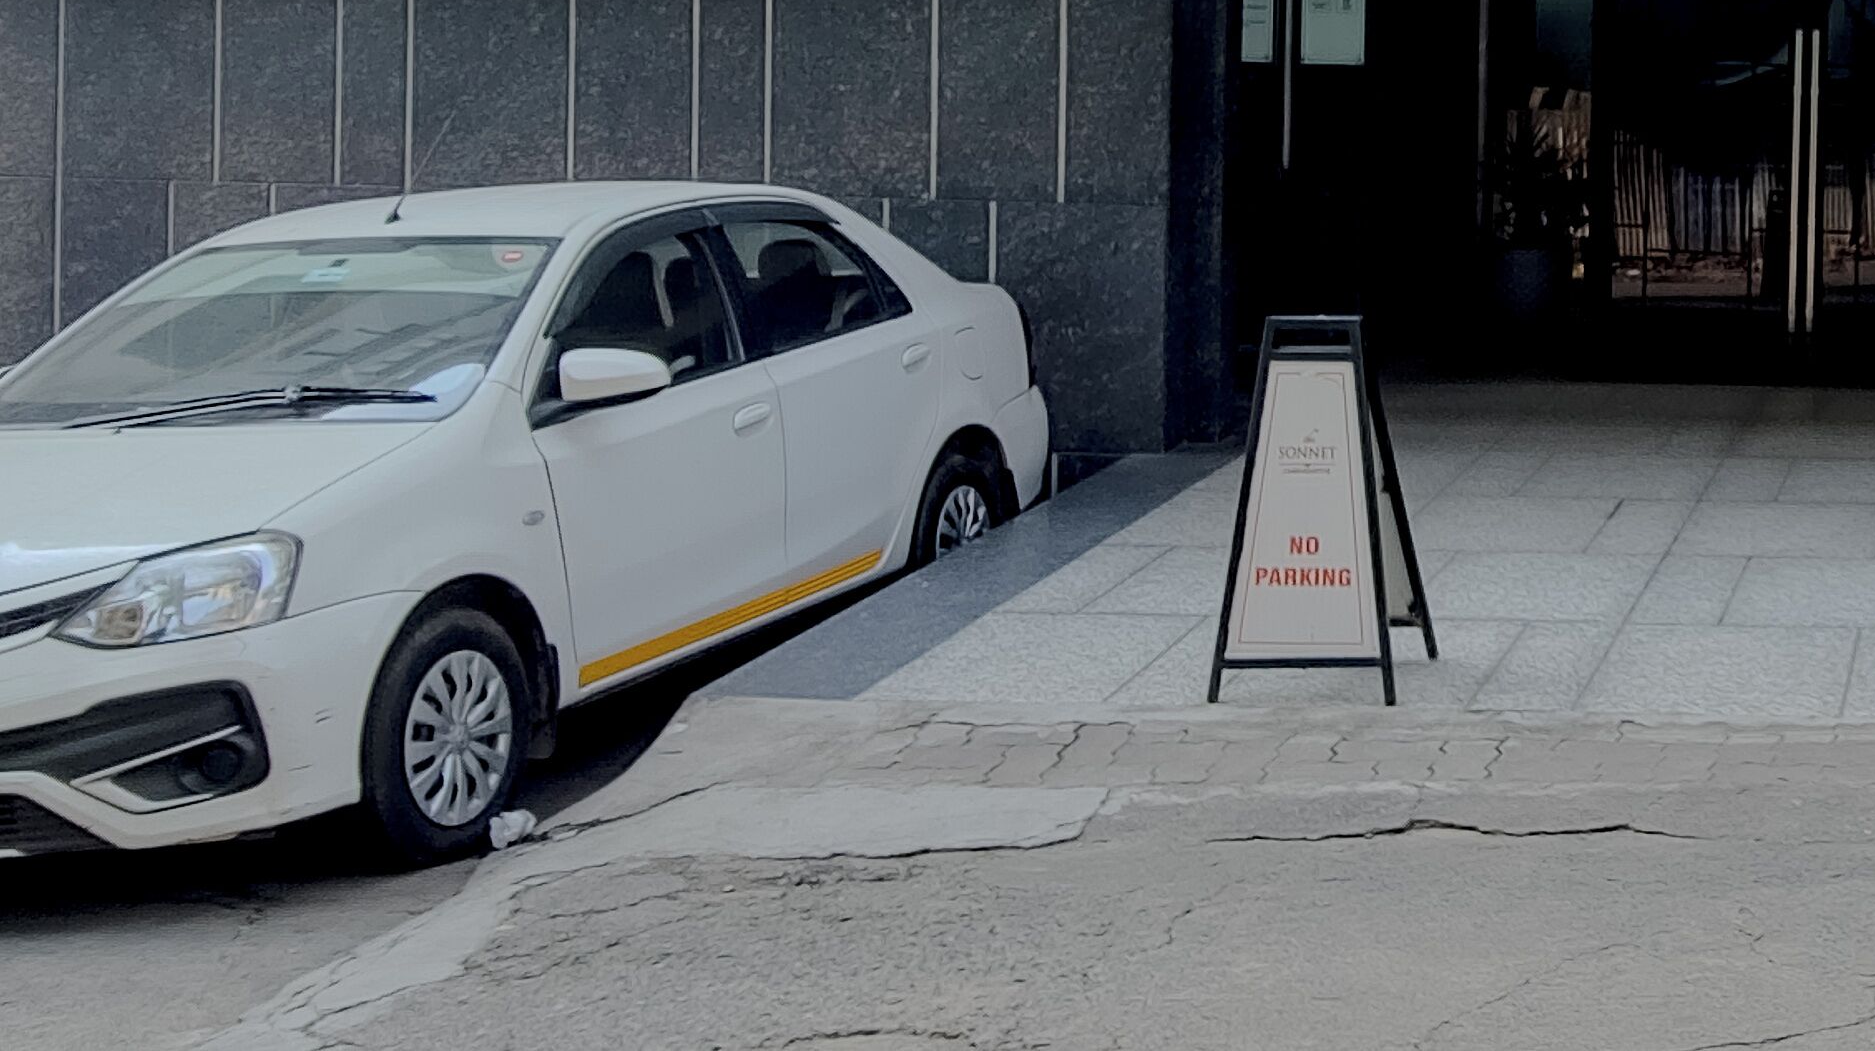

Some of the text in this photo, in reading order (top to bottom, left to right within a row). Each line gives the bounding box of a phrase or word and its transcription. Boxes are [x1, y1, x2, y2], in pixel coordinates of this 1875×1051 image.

[1279, 446, 1336, 460] SONNET
[1289, 536, 1320, 555] NO
[1254, 566, 1352, 587] PARKING
